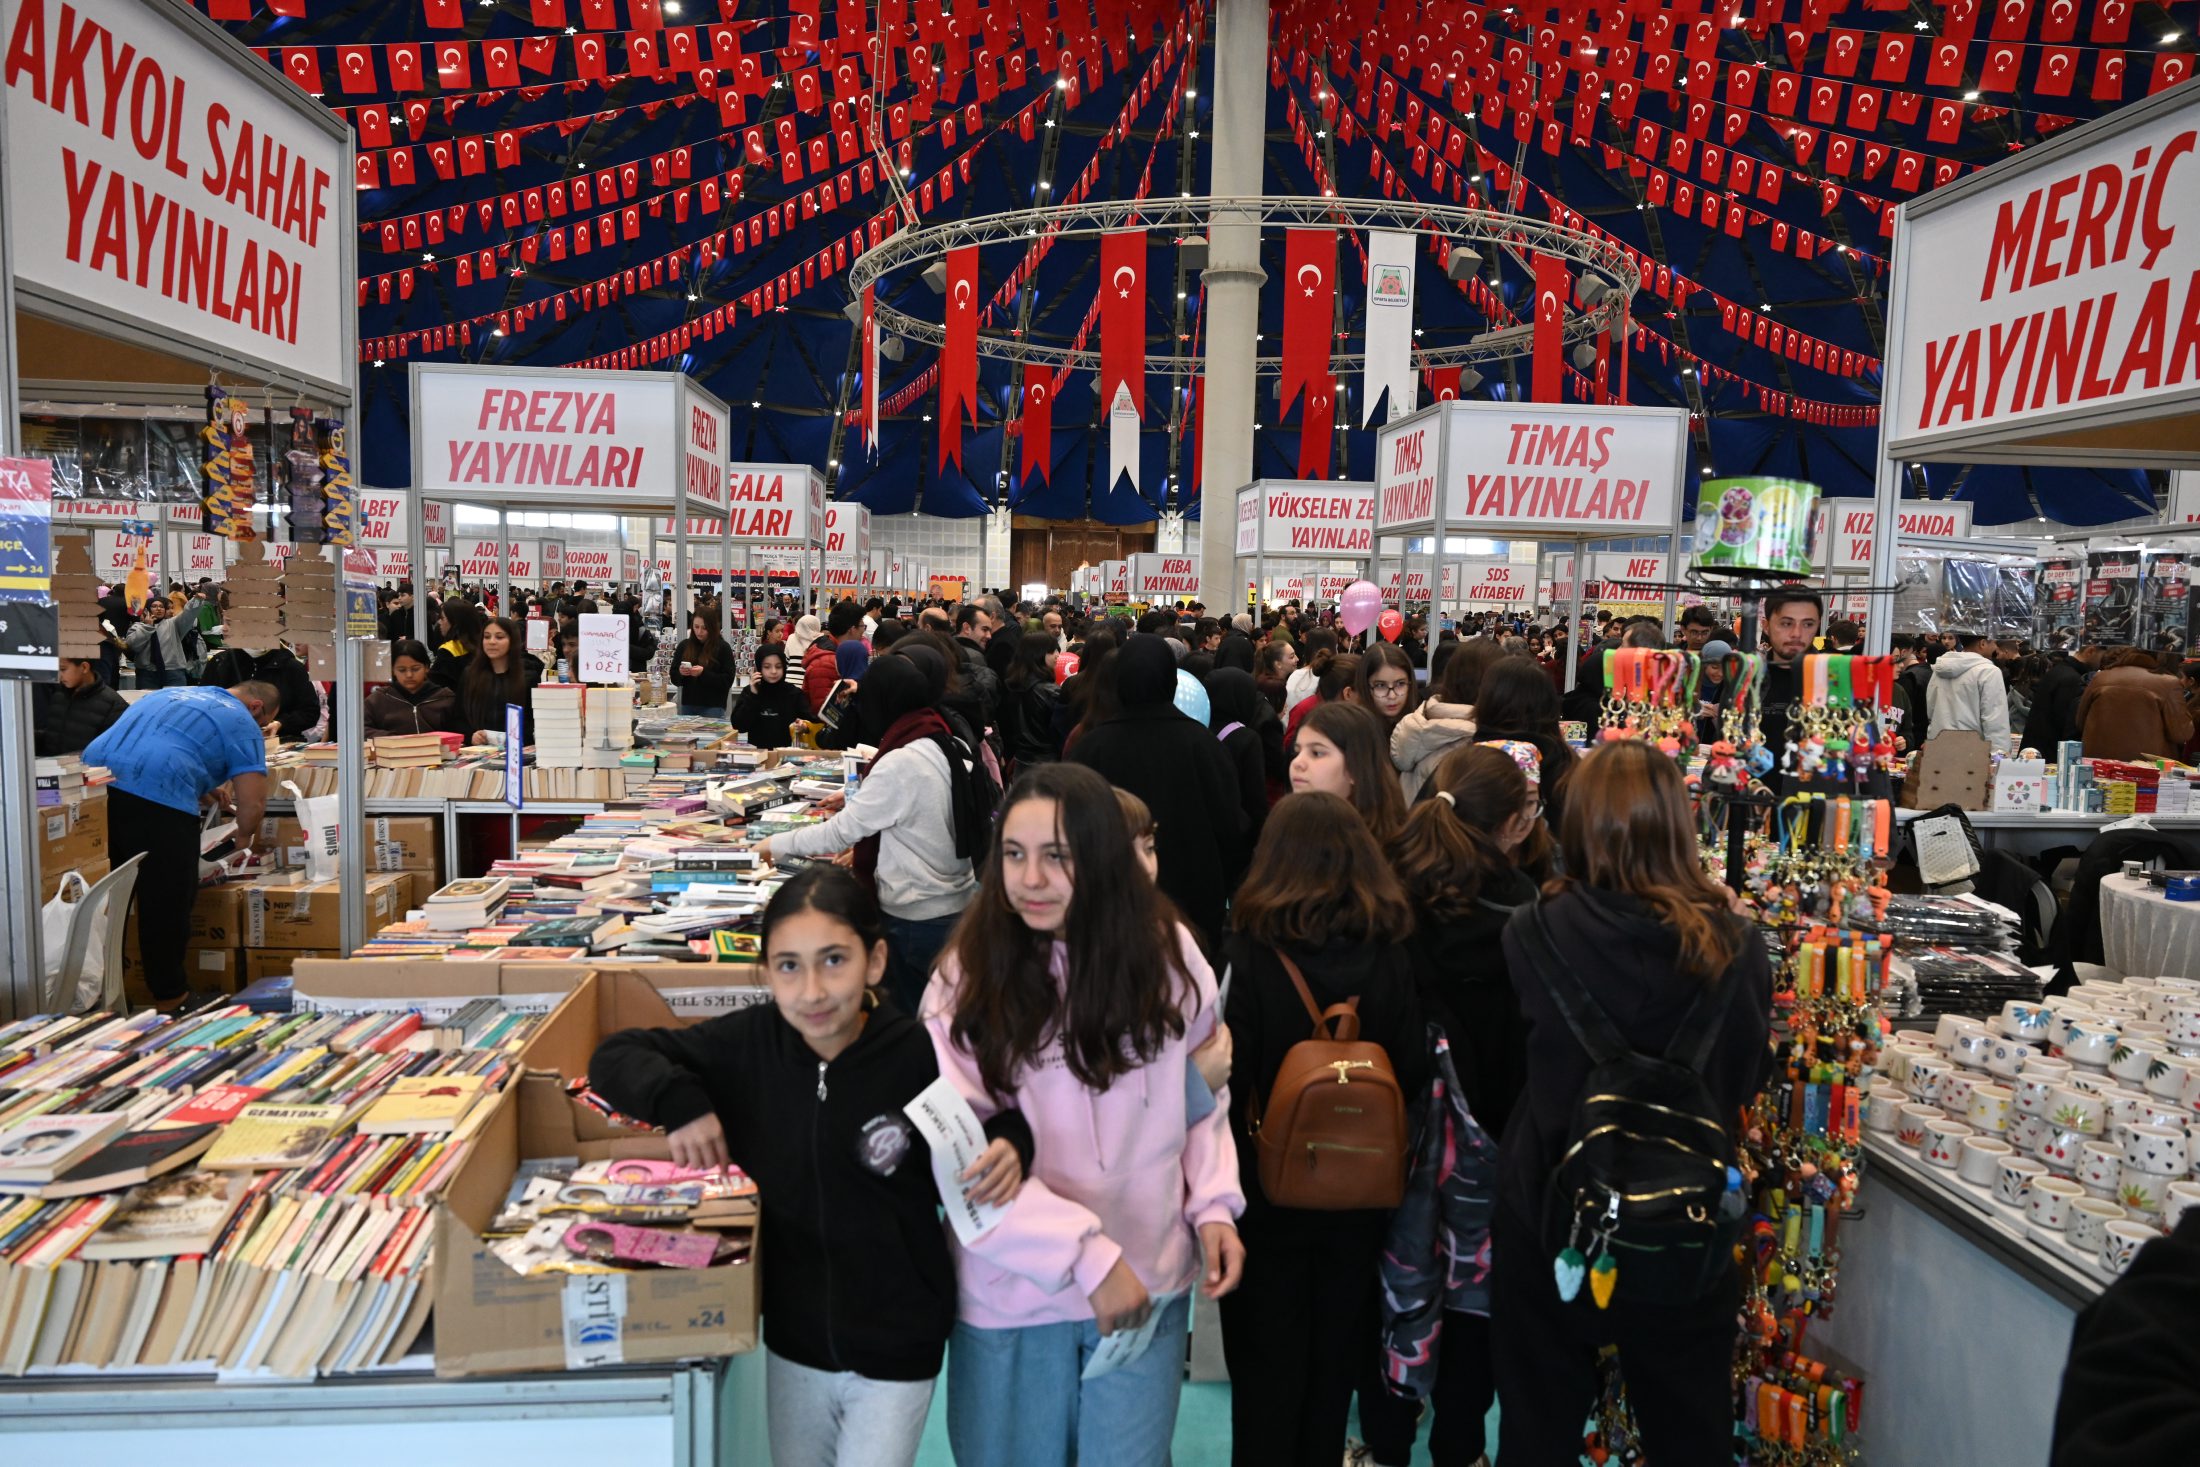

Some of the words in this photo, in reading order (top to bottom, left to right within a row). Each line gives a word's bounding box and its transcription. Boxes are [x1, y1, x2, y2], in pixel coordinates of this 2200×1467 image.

[5, 0, 188, 179] AKYOL
[202, 102, 330, 248] SAHAF
[62, 146, 302, 345] YAYINLARI
[478, 389, 616, 435] FREZYA
[692, 405, 717, 455] FREZYA
[448, 440, 644, 488] YAYINLARI
[686, 452, 721, 503] YAYINLARI
[1269, 492, 1352, 519] YÜKSELEN
[1383, 476, 1434, 524] YAYINLARI
[1465, 475, 1651, 521] YAYINLARI
[191, 556, 214, 568] SAHAF
[462, 560, 530, 576] YAYINARI
[564, 552, 608, 564] KORDON
[1627, 558, 1659, 578] NEF
[30, 565, 44, 574] 34
[1391, 573, 1424, 585] MRTI
[1486, 568, 1510, 582] SDS
[1470, 584, 1525, 600] KİTABEVİ
[1600, 580, 1683, 601] YAYINLAI
[38, 645, 52, 655] 34
